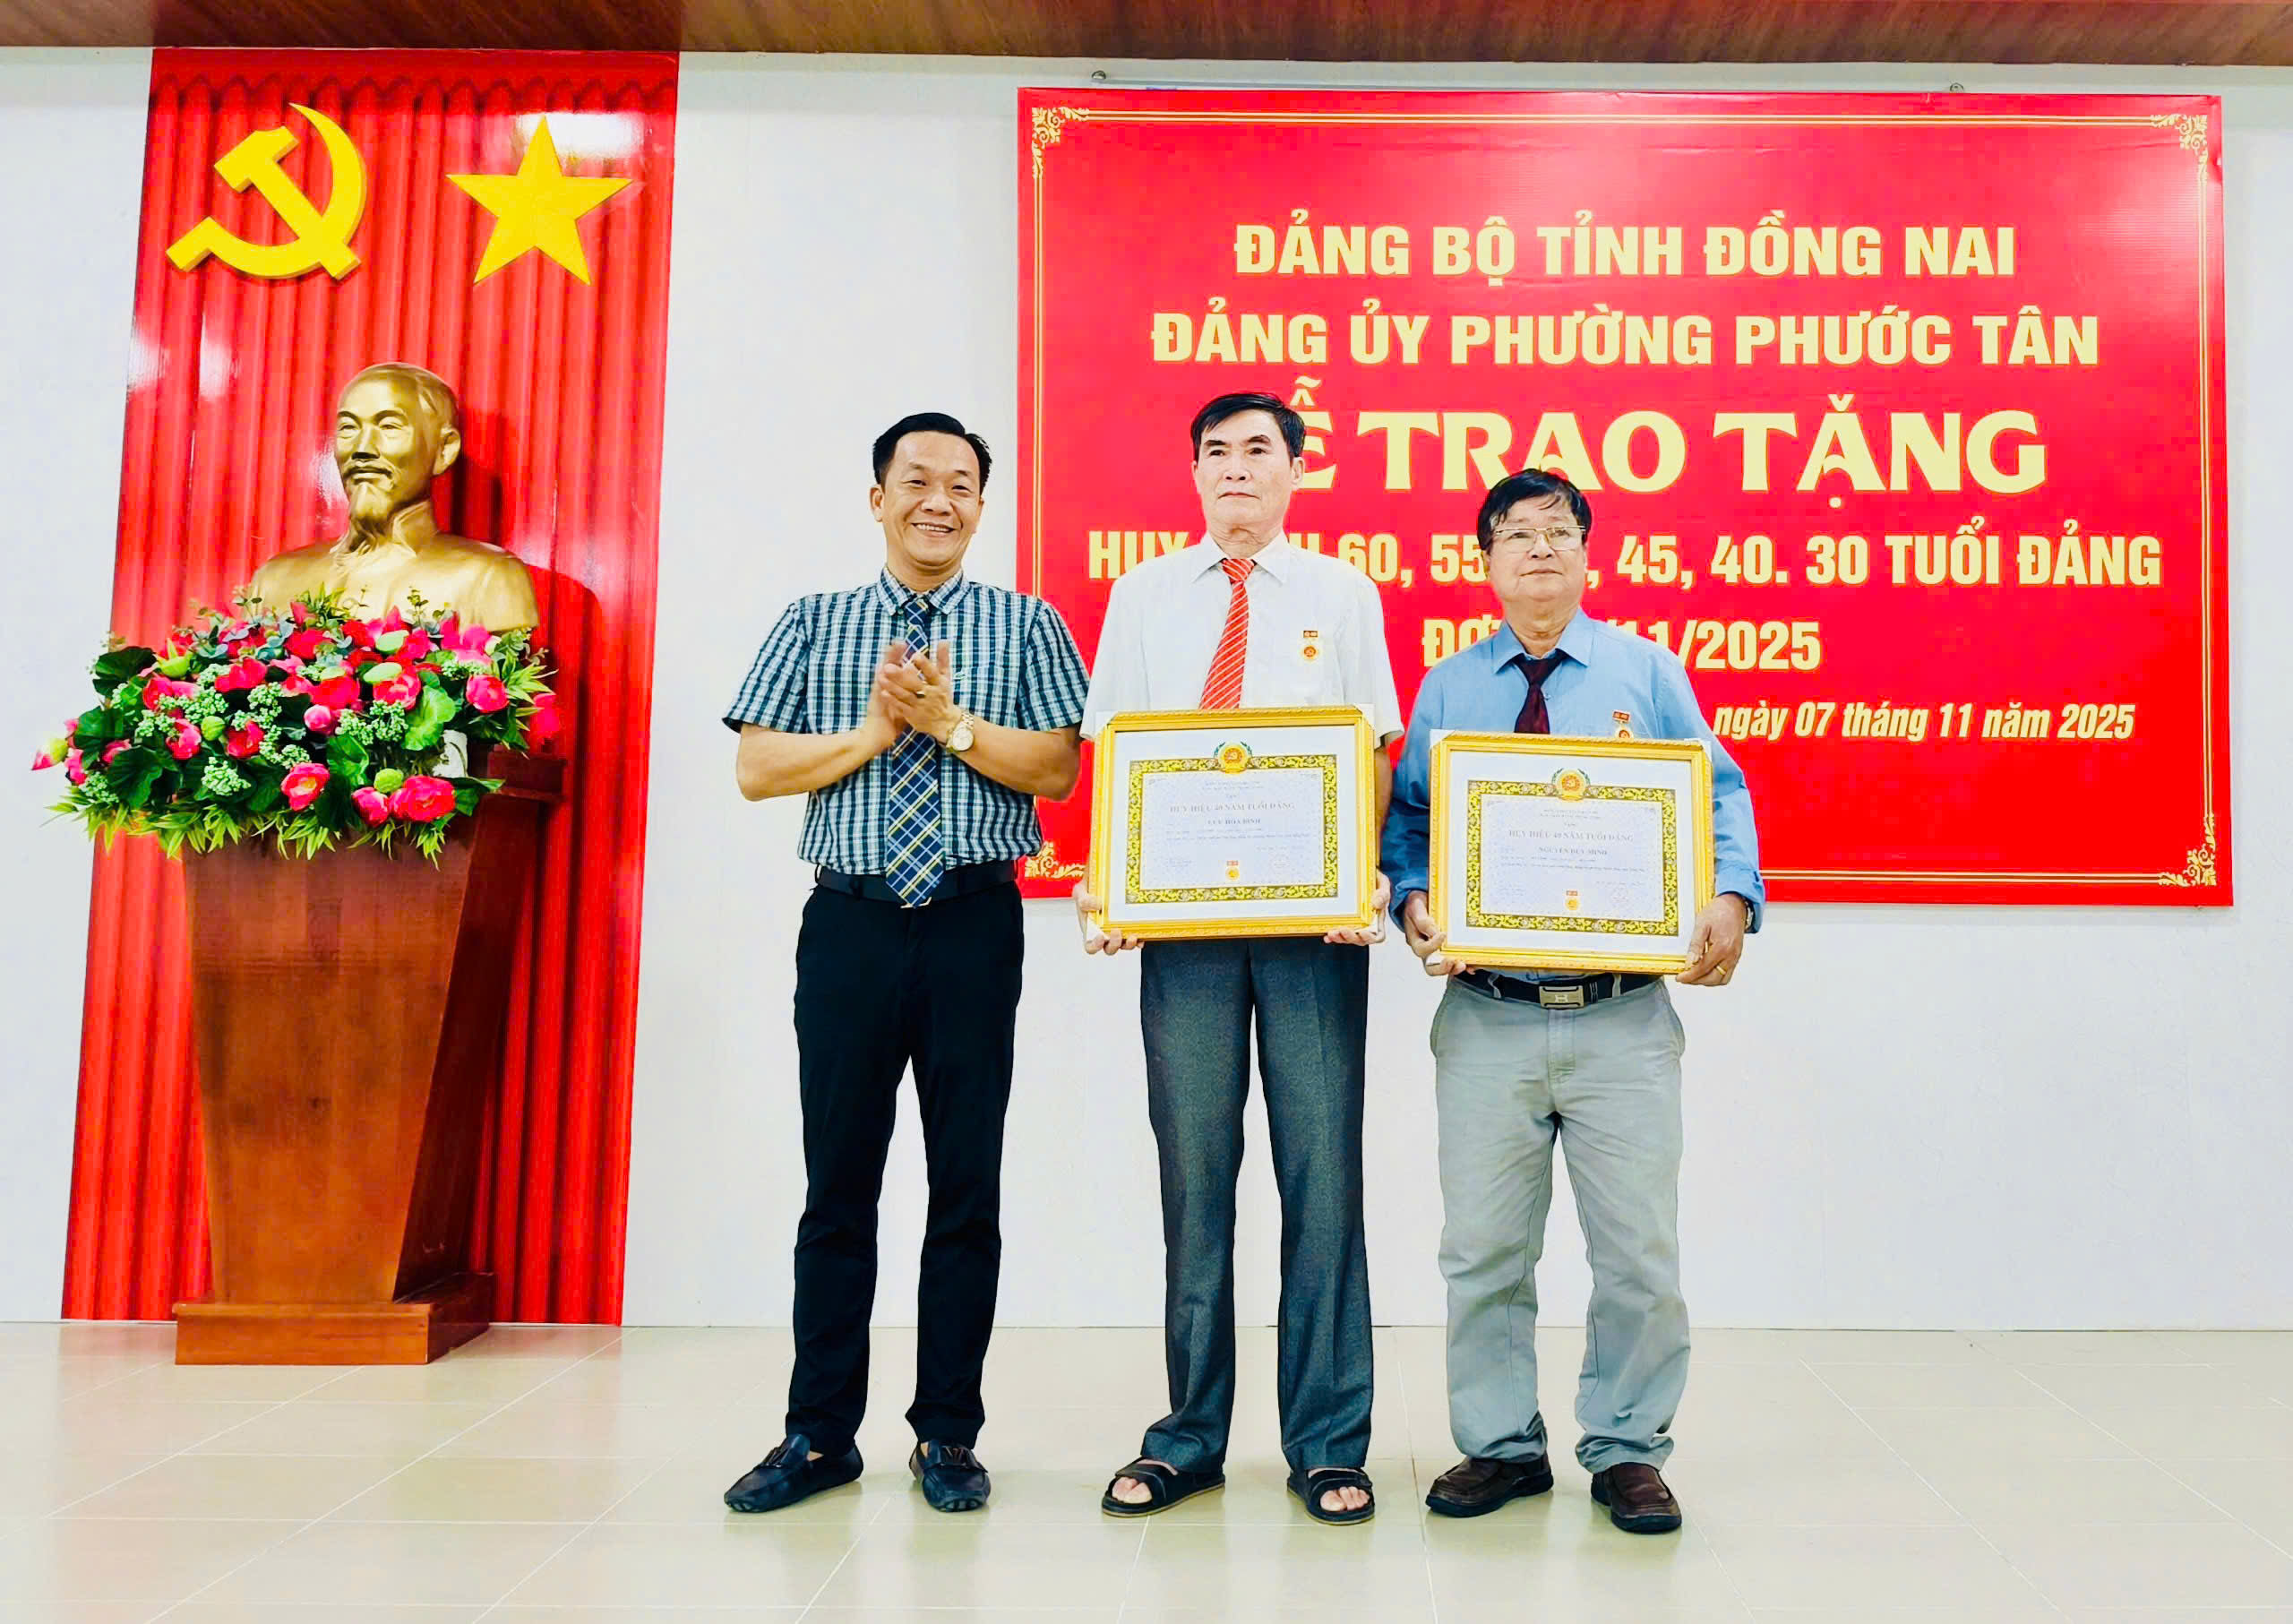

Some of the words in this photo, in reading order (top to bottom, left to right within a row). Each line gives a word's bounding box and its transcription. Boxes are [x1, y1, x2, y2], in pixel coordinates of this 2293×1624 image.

[1234, 209, 1409, 275] ĐẢNG
[1433, 215, 1517, 287] BỘ
[1533, 209, 1682, 276] TỈNH
[1704, 210, 1881, 276] ĐỒNG
[1905, 227, 2014, 275] NAI
[1151, 296, 1327, 363] ĐẢNG
[1351, 298, 1430, 364] ỦY
[1452, 304, 1712, 365] PHƯỜNG
[1736, 305, 1950, 365] PHƯỚC
[1973, 305, 2098, 365] TÂN
[1290, 375, 1335, 489] Ễ
[1357, 411, 1686, 492] TRAO
[1713, 394, 2045, 508] TẶNG
[1338, 533, 1412, 588] 60,
[1618, 536, 1692, 589] 45,
[1711, 536, 1787, 583] 40.
[1807, 536, 1868, 584] 30
[1885, 516, 1999, 584] TUỔI
[2017, 520, 2160, 585] ĐẢNG
[1713, 700, 1788, 741] ngày
[1795, 702, 1835, 736] 07
[1842, 702, 1928, 742] tháng
[1941, 703, 1971, 737] 11
[1982, 702, 2050, 738] năm
[2057, 704, 2135, 739] 2025
